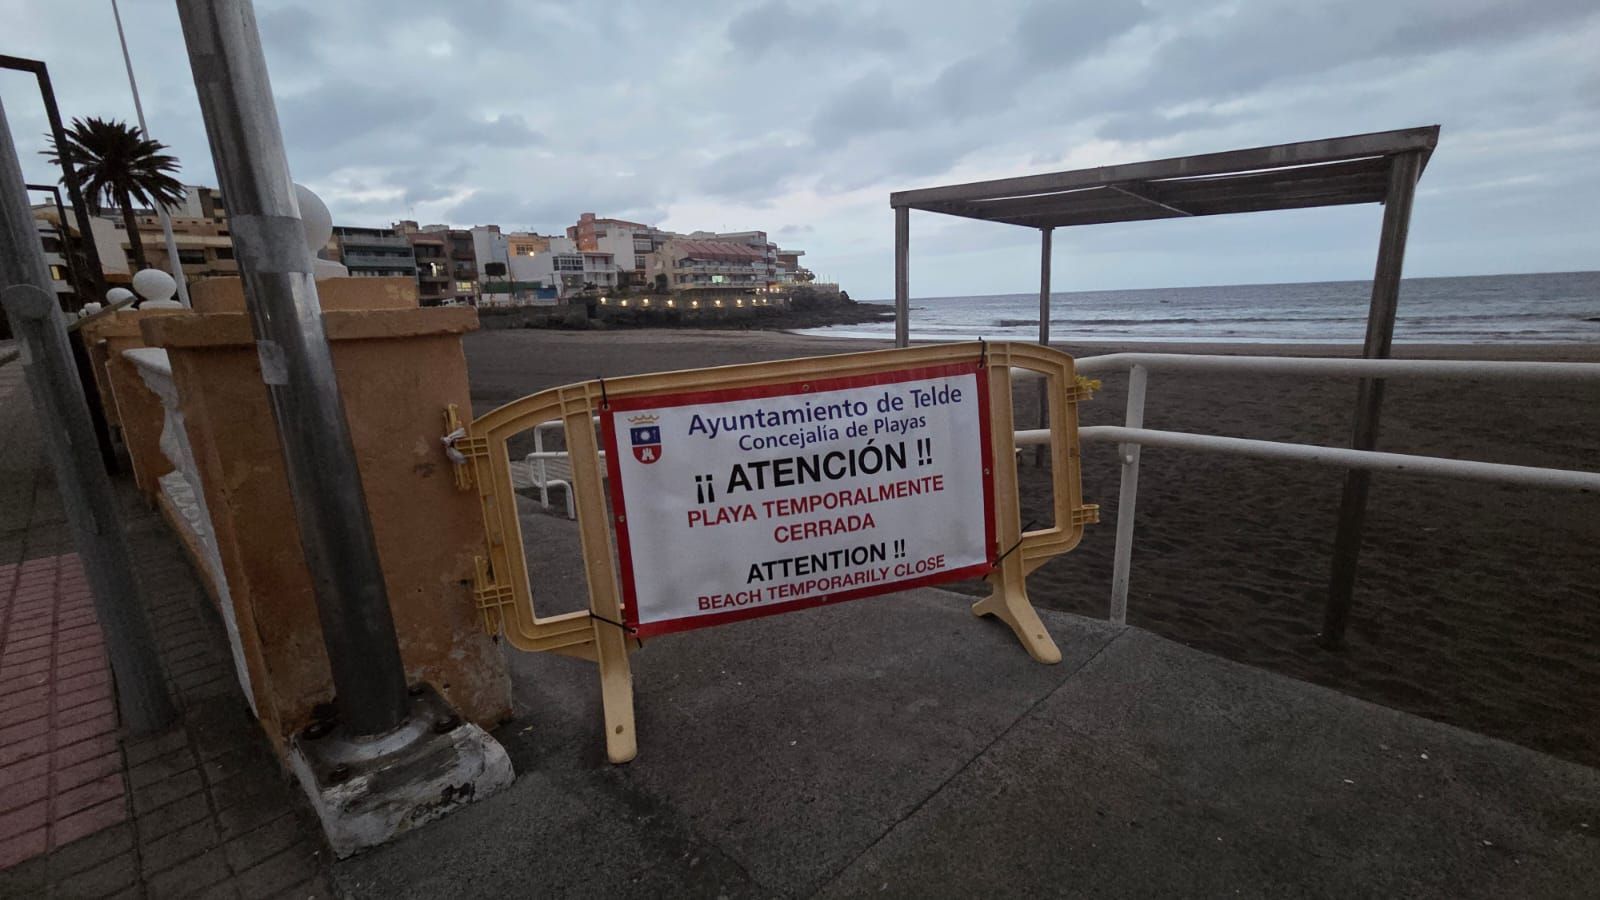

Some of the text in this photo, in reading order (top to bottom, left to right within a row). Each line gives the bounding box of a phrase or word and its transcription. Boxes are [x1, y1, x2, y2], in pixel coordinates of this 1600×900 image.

[688, 384, 963, 436] Ayuntamiento de Telde
[738, 413, 927, 450] Concejalía de Playas
[726, 438, 907, 493] ATENCIÓN
[687, 474, 945, 528] PLAYA TEMPORALMENTE
[773, 513, 876, 544] CERRADA
[698, 554, 946, 611] BEACH TEMPORARILY CLOSE
[746, 542, 886, 584] ATTENTION
